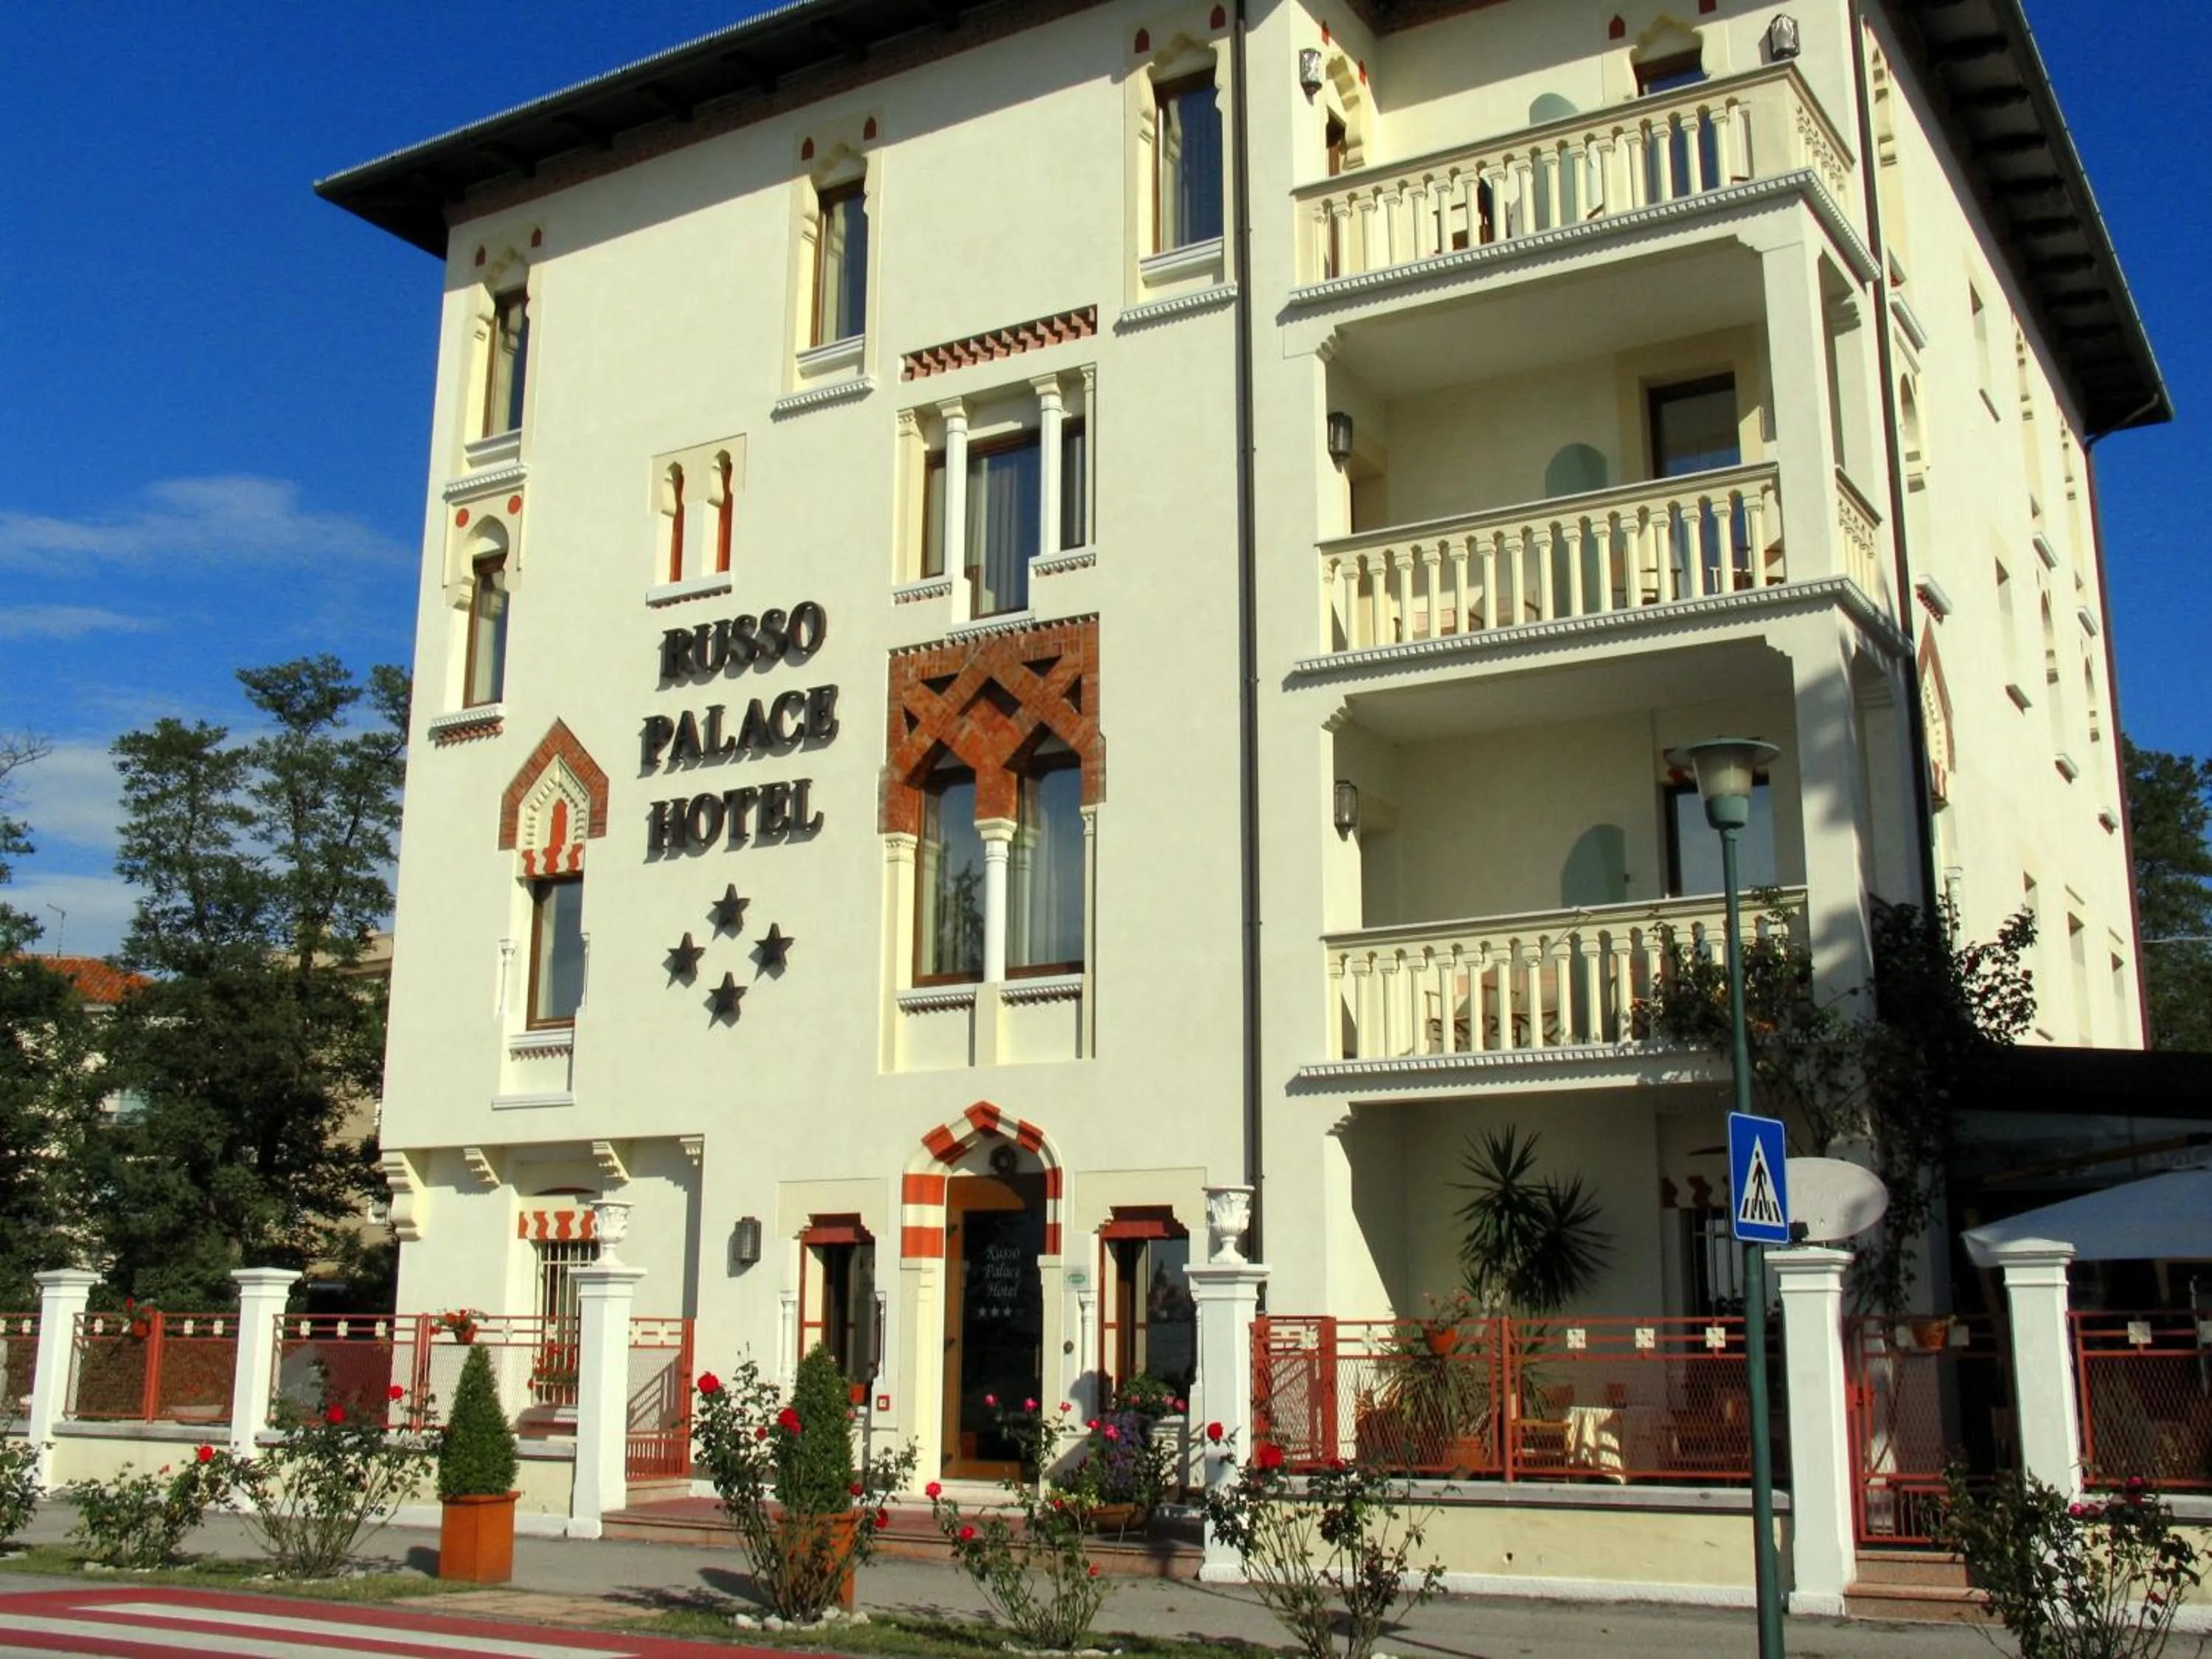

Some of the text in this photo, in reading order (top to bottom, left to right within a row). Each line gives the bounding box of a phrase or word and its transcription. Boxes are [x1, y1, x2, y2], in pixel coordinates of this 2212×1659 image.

[658, 601, 827, 678] RUSSO
[640, 684, 840, 766] PALACE
[646, 778, 824, 853] HOTEL
[984, 1262, 1020, 1278] Palace
